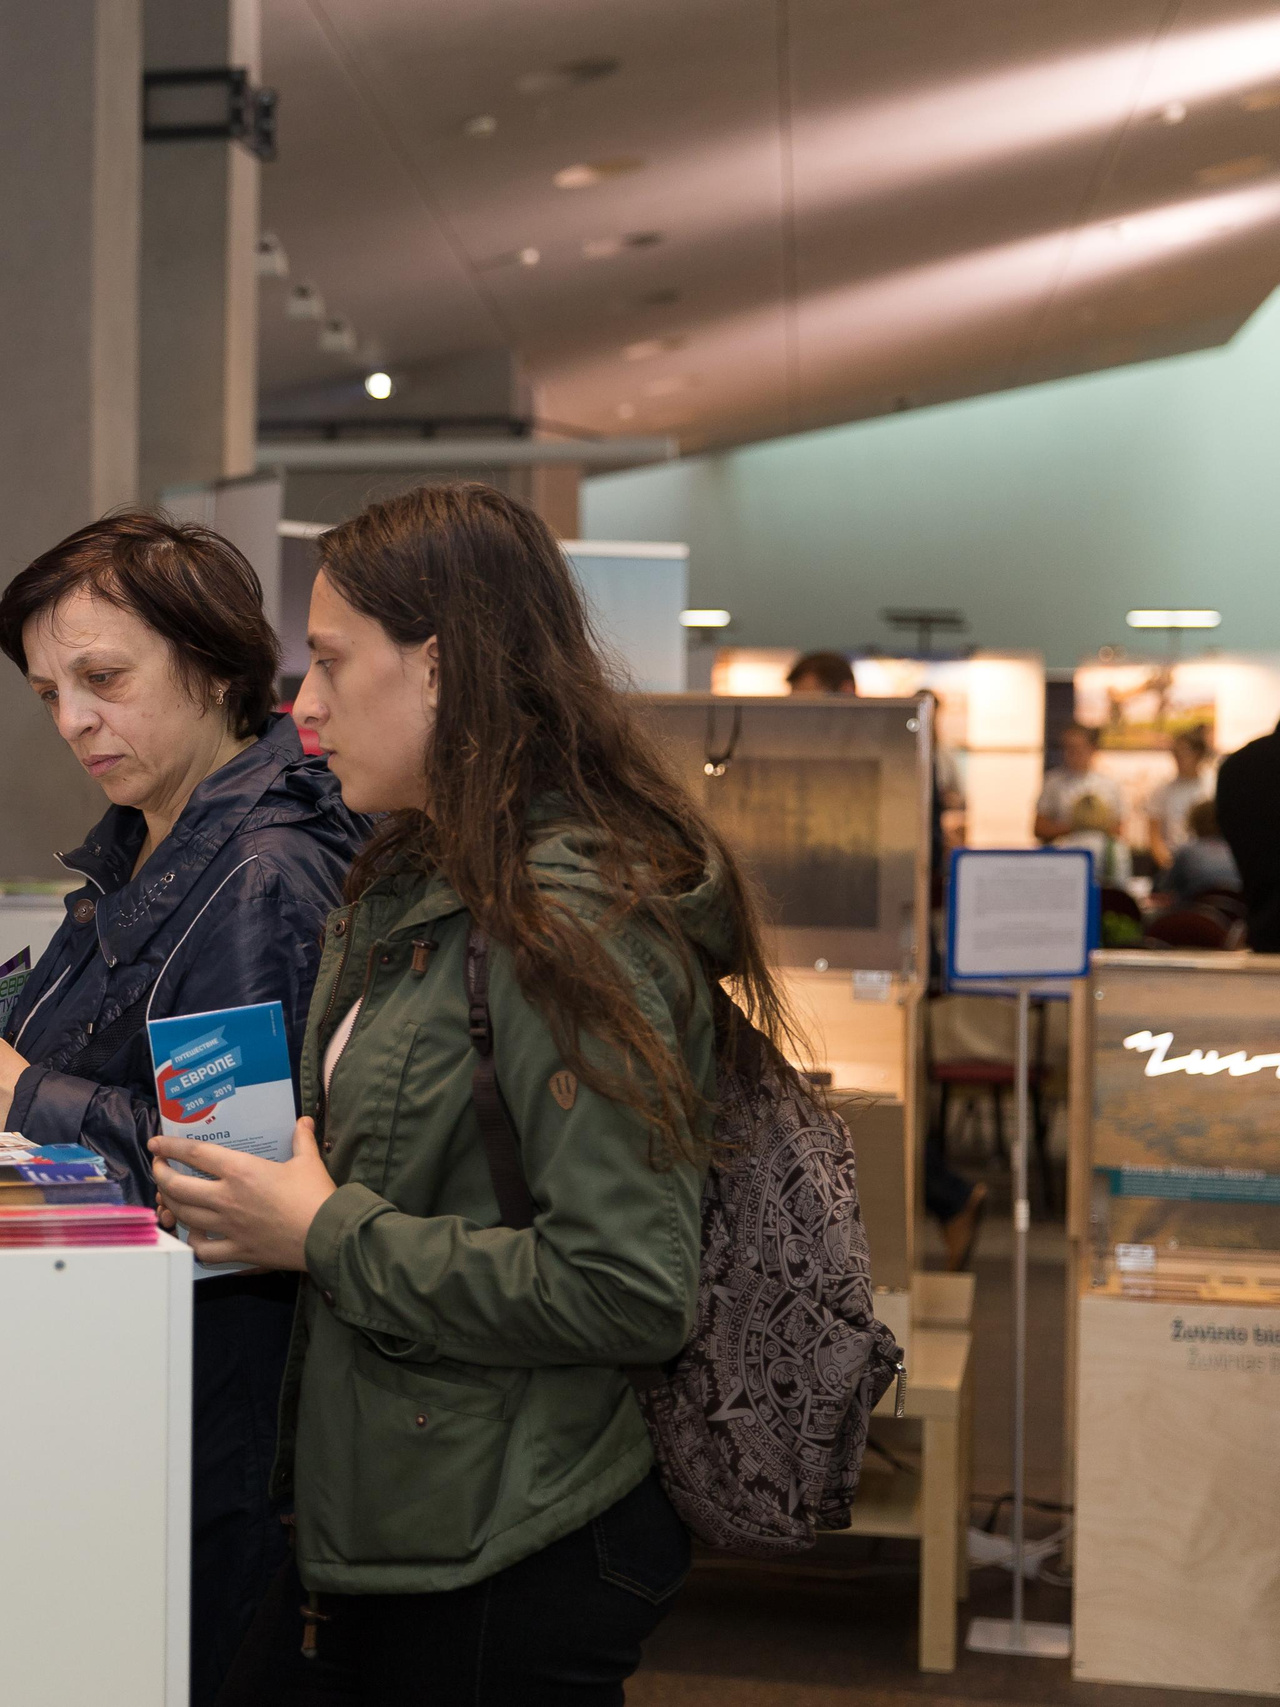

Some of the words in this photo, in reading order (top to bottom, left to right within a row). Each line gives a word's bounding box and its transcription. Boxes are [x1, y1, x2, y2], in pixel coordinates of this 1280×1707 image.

[174, 1037, 220, 1064] ПУТЕШЕСТВИЕ
[179, 1054, 236, 1088] ЕВРОПЕ
[185, 1097, 205, 1111] 2018
[213, 1084, 233, 1099] 2019
[186, 1129, 231, 1142] Европа
